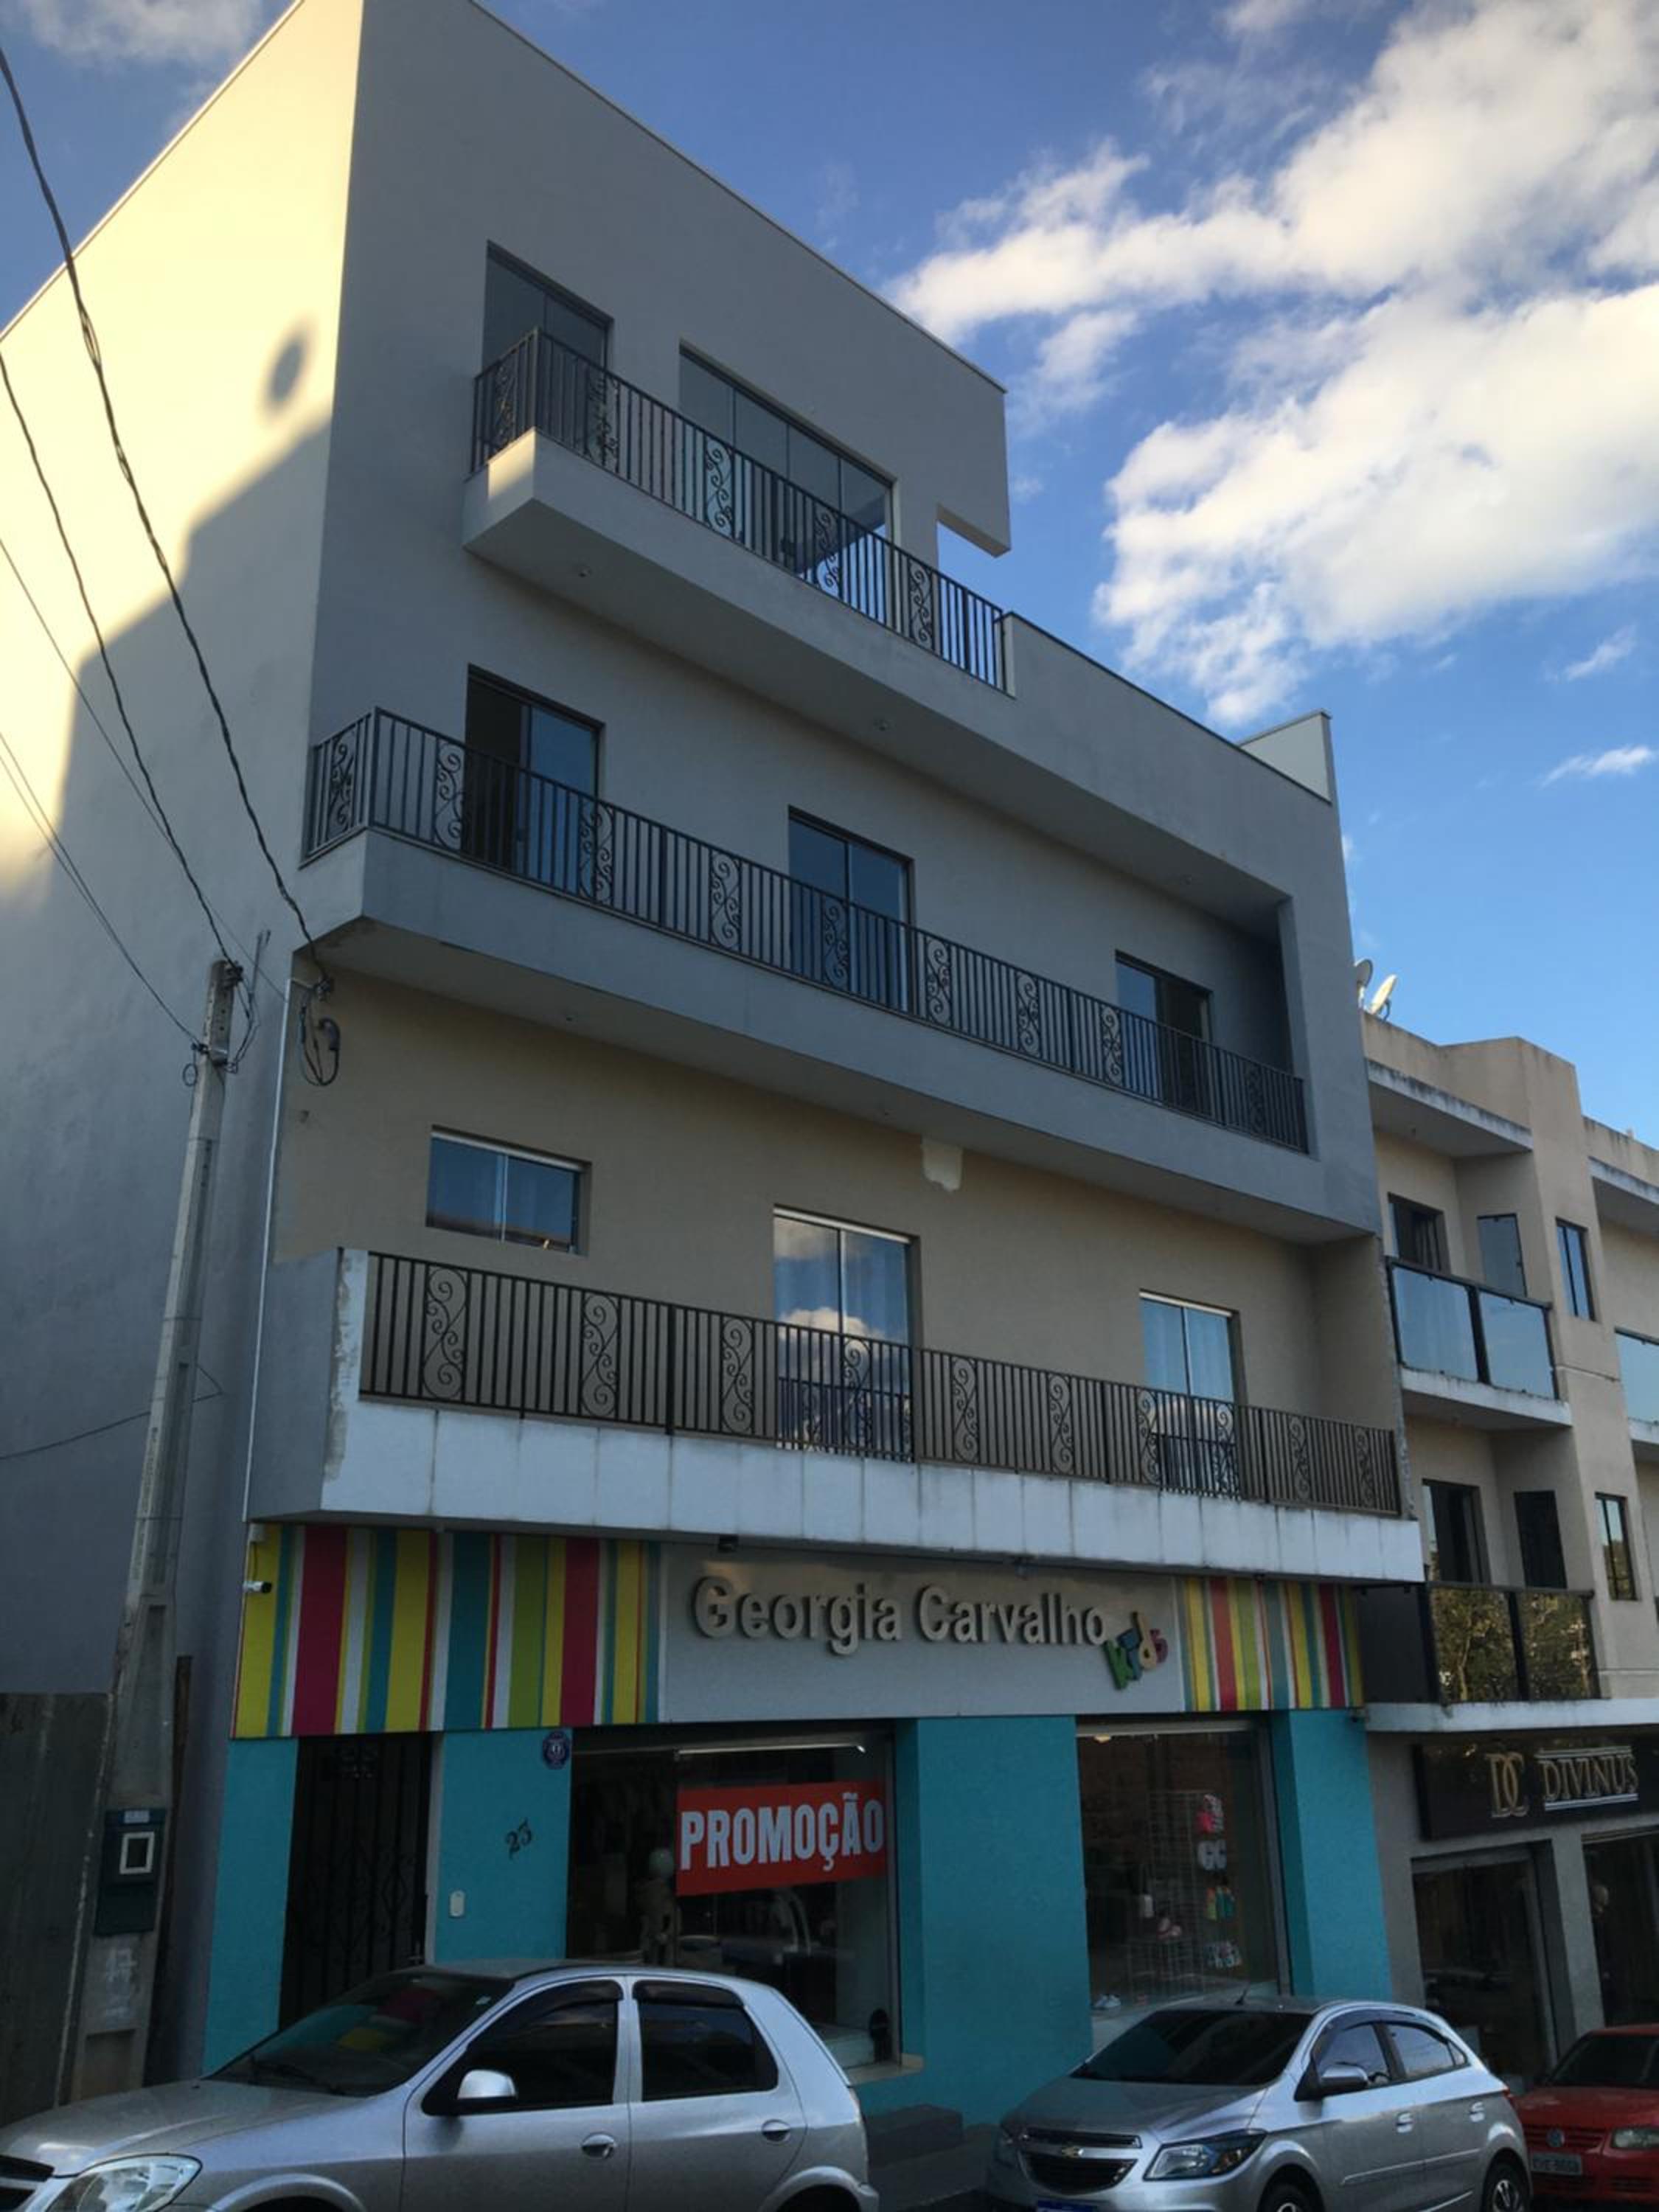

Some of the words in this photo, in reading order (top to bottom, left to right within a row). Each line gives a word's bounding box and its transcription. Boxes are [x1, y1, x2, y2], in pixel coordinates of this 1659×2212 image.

[691, 1575, 900, 1657] Georgia
[915, 1584, 1107, 1646] Carvalho
[1537, 1754, 1639, 1801] DIVINUS
[680, 1791, 884, 1872] PROMOÇÃO
